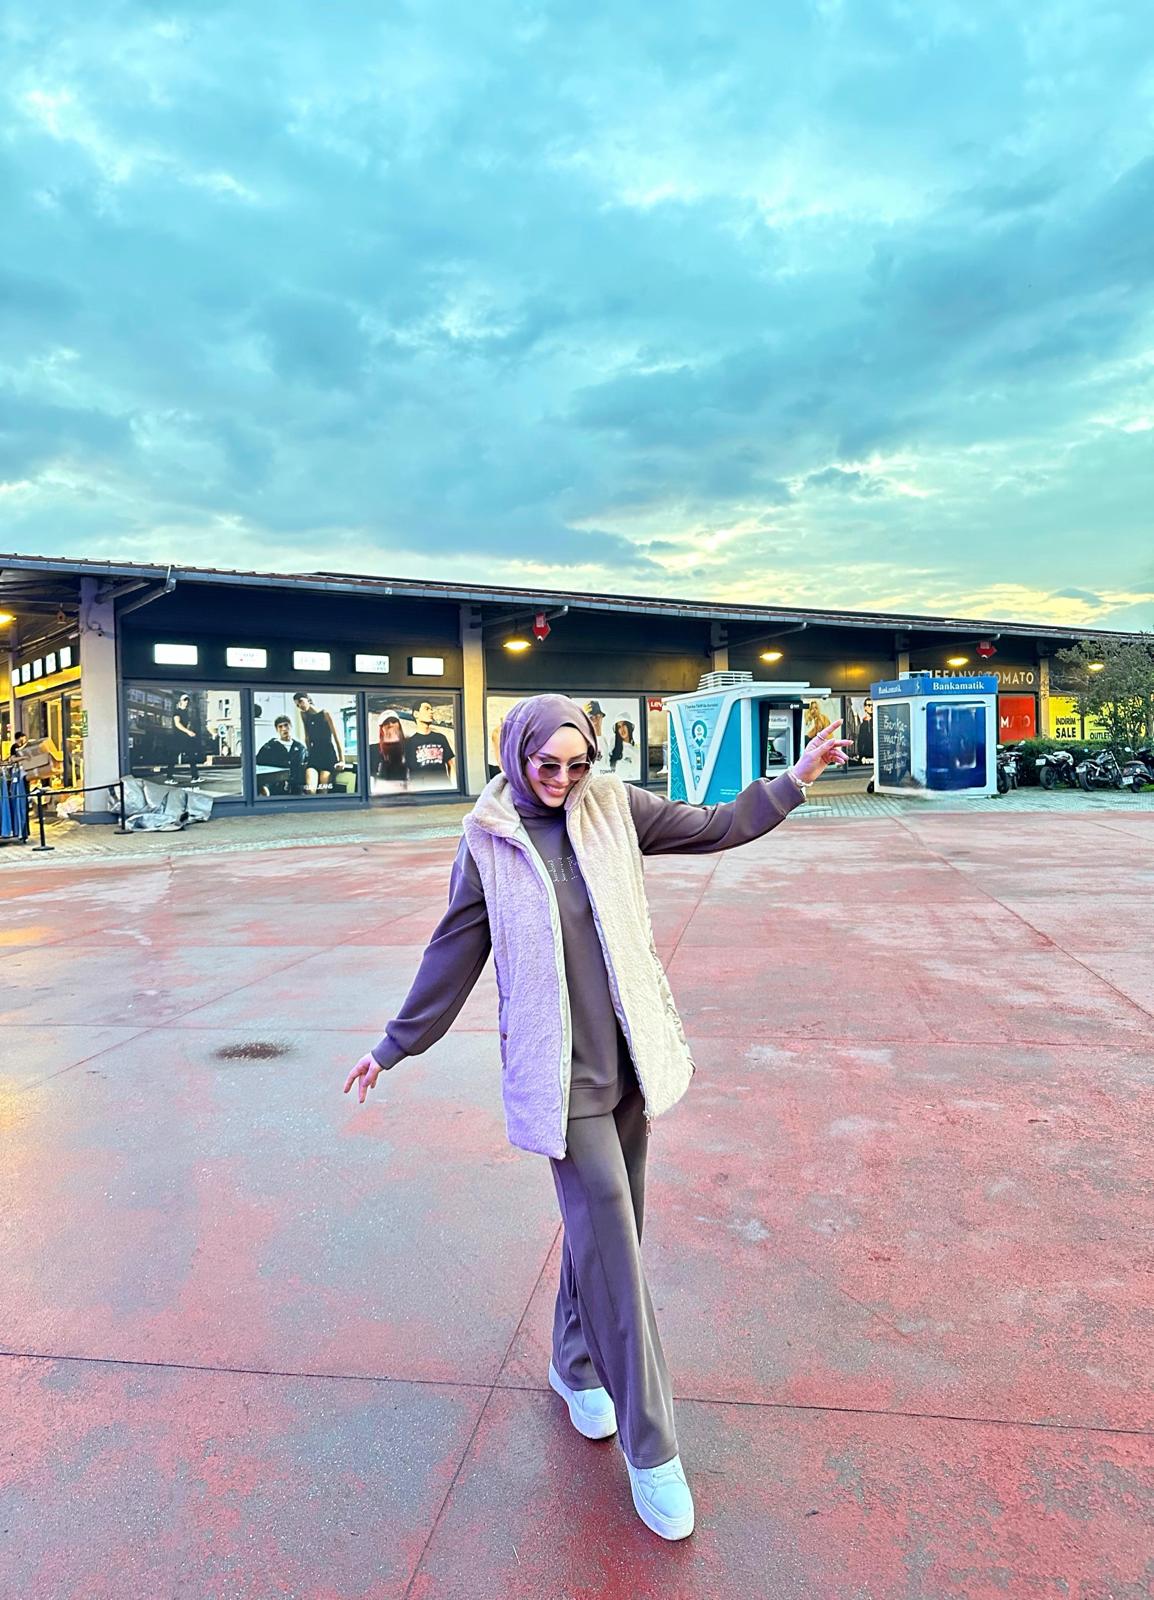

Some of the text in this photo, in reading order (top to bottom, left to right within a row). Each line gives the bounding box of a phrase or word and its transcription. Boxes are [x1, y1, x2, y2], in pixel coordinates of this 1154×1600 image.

[984, 671, 1034, 685] OMATO
[933, 681, 985, 690] Bankamatik
[1055, 727, 1076, 738] SALE
